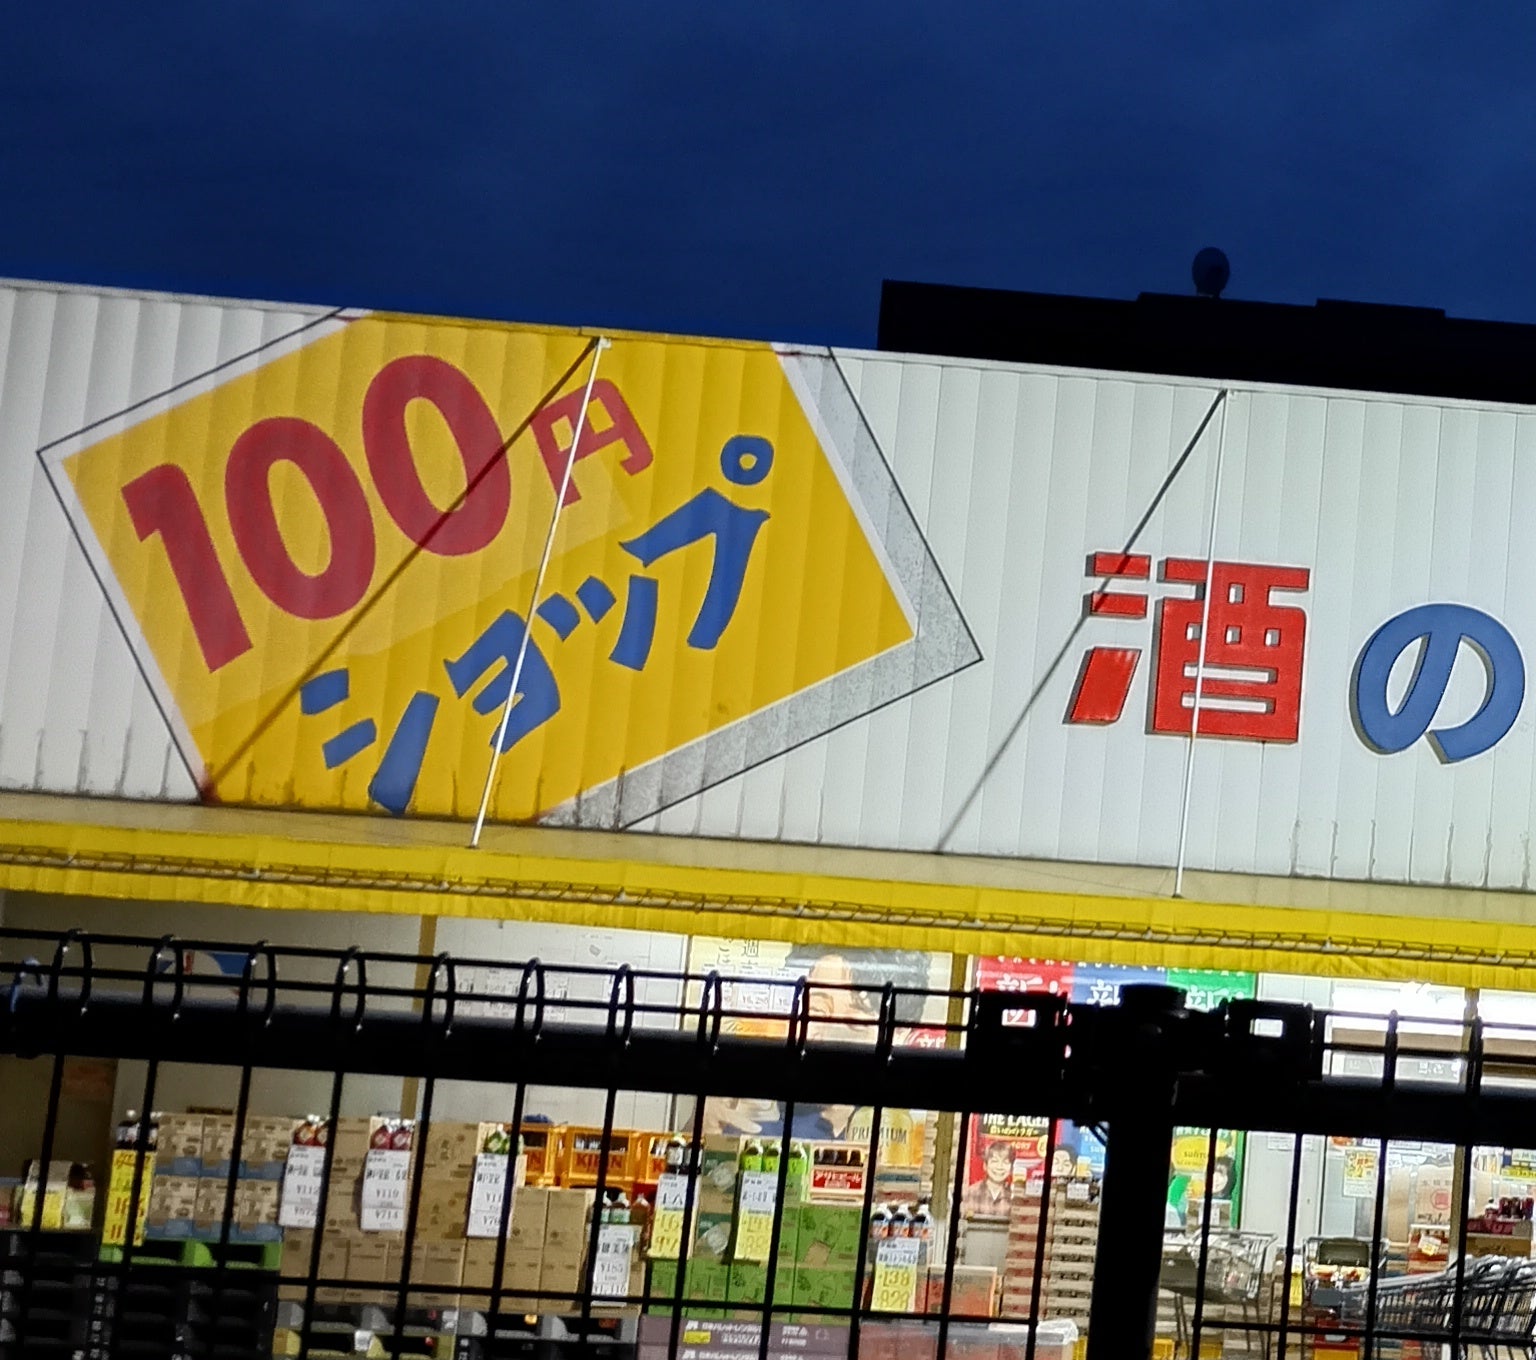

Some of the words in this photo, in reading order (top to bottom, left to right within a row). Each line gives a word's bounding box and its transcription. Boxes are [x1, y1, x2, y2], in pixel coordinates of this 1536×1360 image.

[121, 354, 653, 673] 100円
[300, 434, 775, 815] ショップ
[575, 1151, 623, 1169] KIN
[852, 1126, 907, 1144] PRIUM
